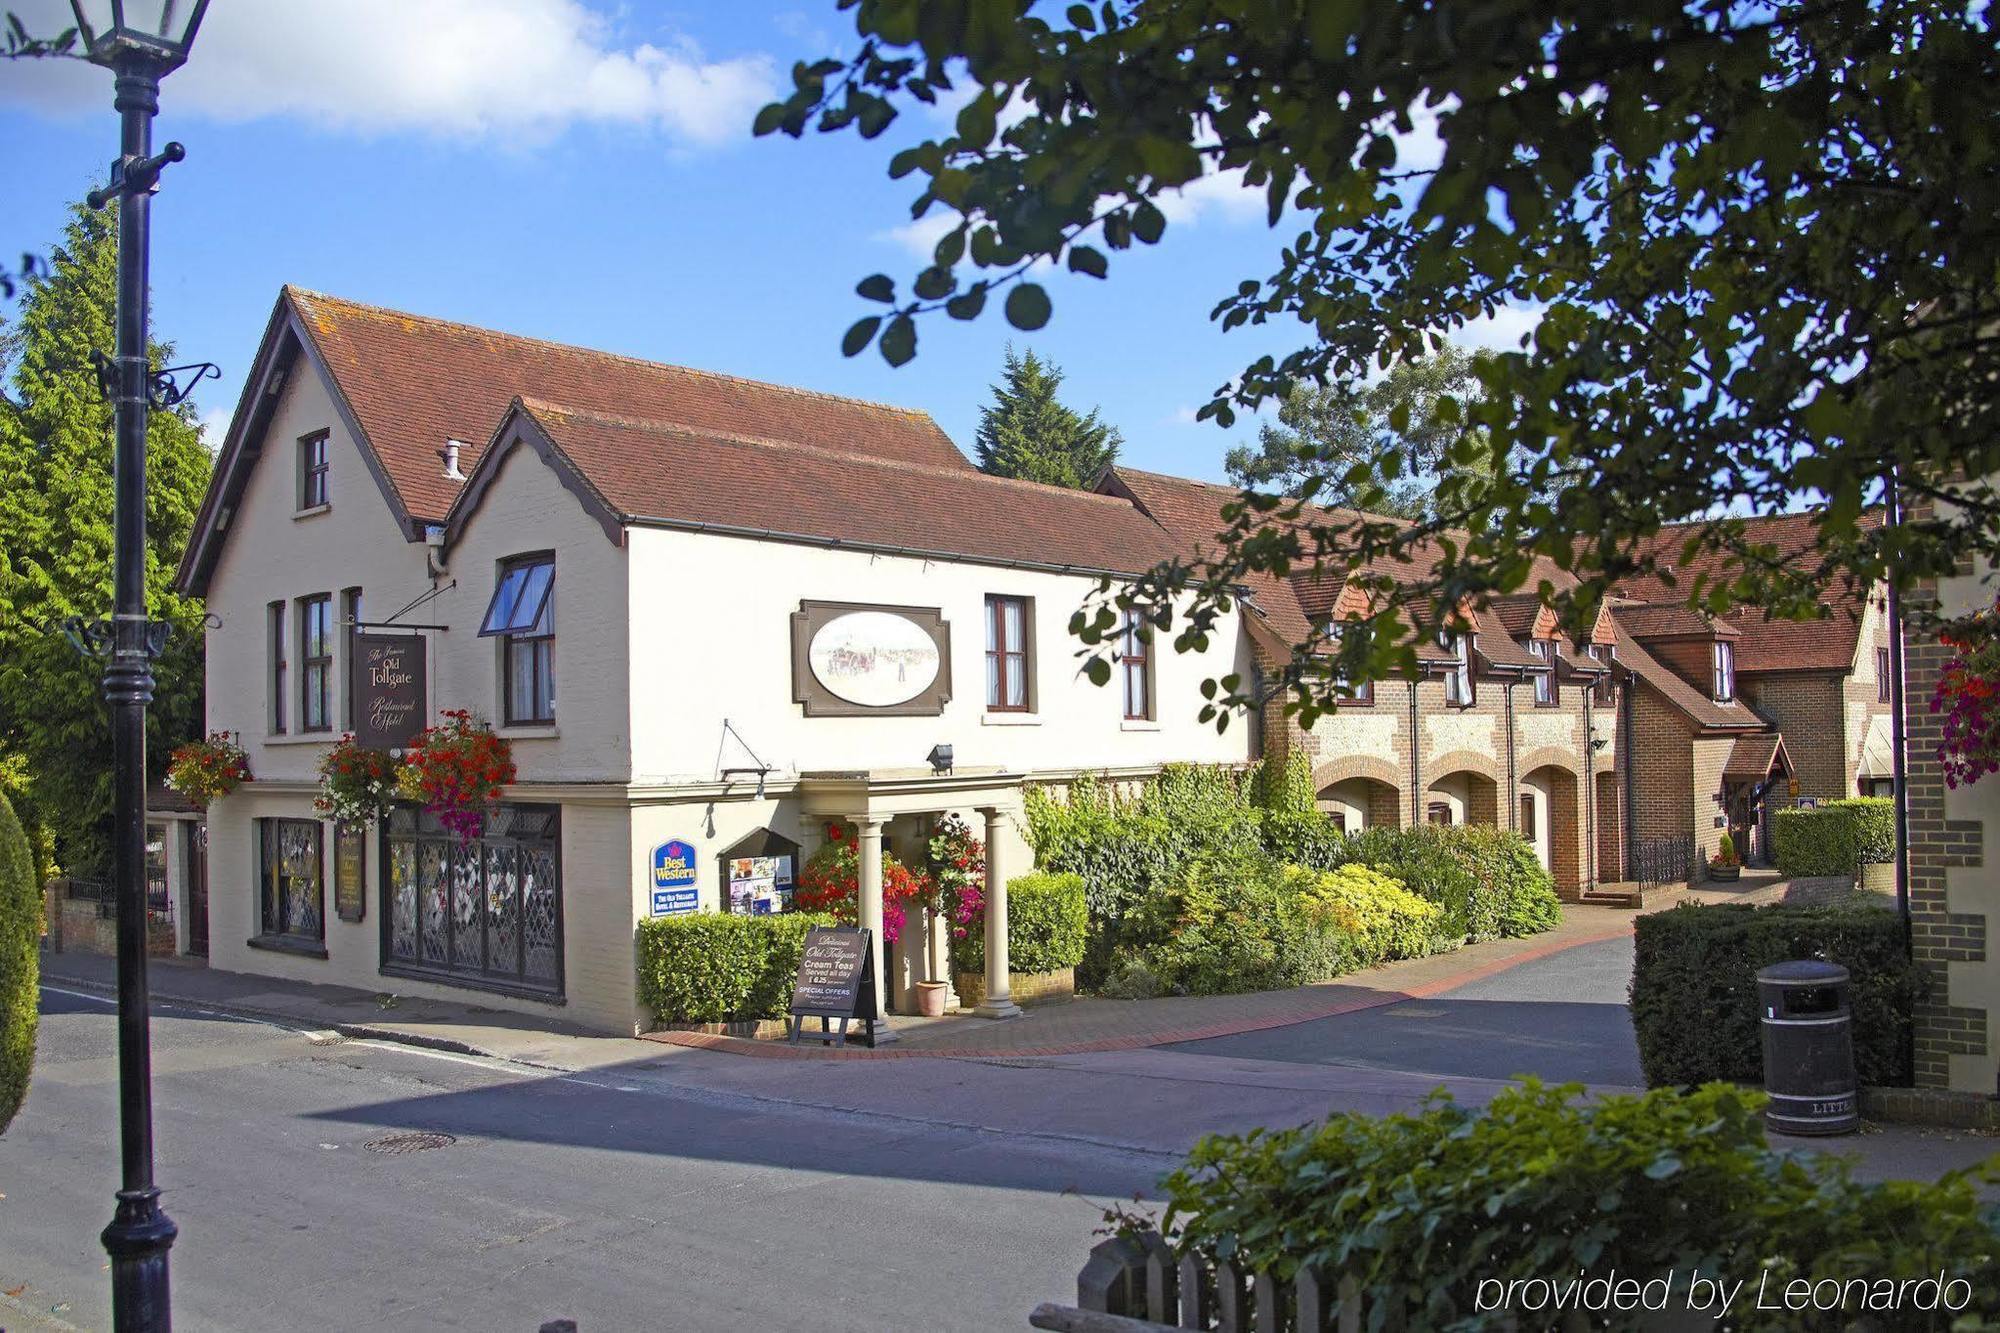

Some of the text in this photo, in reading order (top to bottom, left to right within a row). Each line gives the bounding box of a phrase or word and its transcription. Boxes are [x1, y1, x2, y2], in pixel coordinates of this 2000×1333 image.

[383, 658, 400, 670] Old
[369, 667, 412, 689] Tollgate
[664, 856, 686, 869] Best
[656, 868, 696, 880] Western
[804, 960, 854, 970] Cream Teas
[805, 968, 829, 976] Served
[838, 970, 851, 978] day
[799, 986, 850, 996] SPECIAL OFFERS
